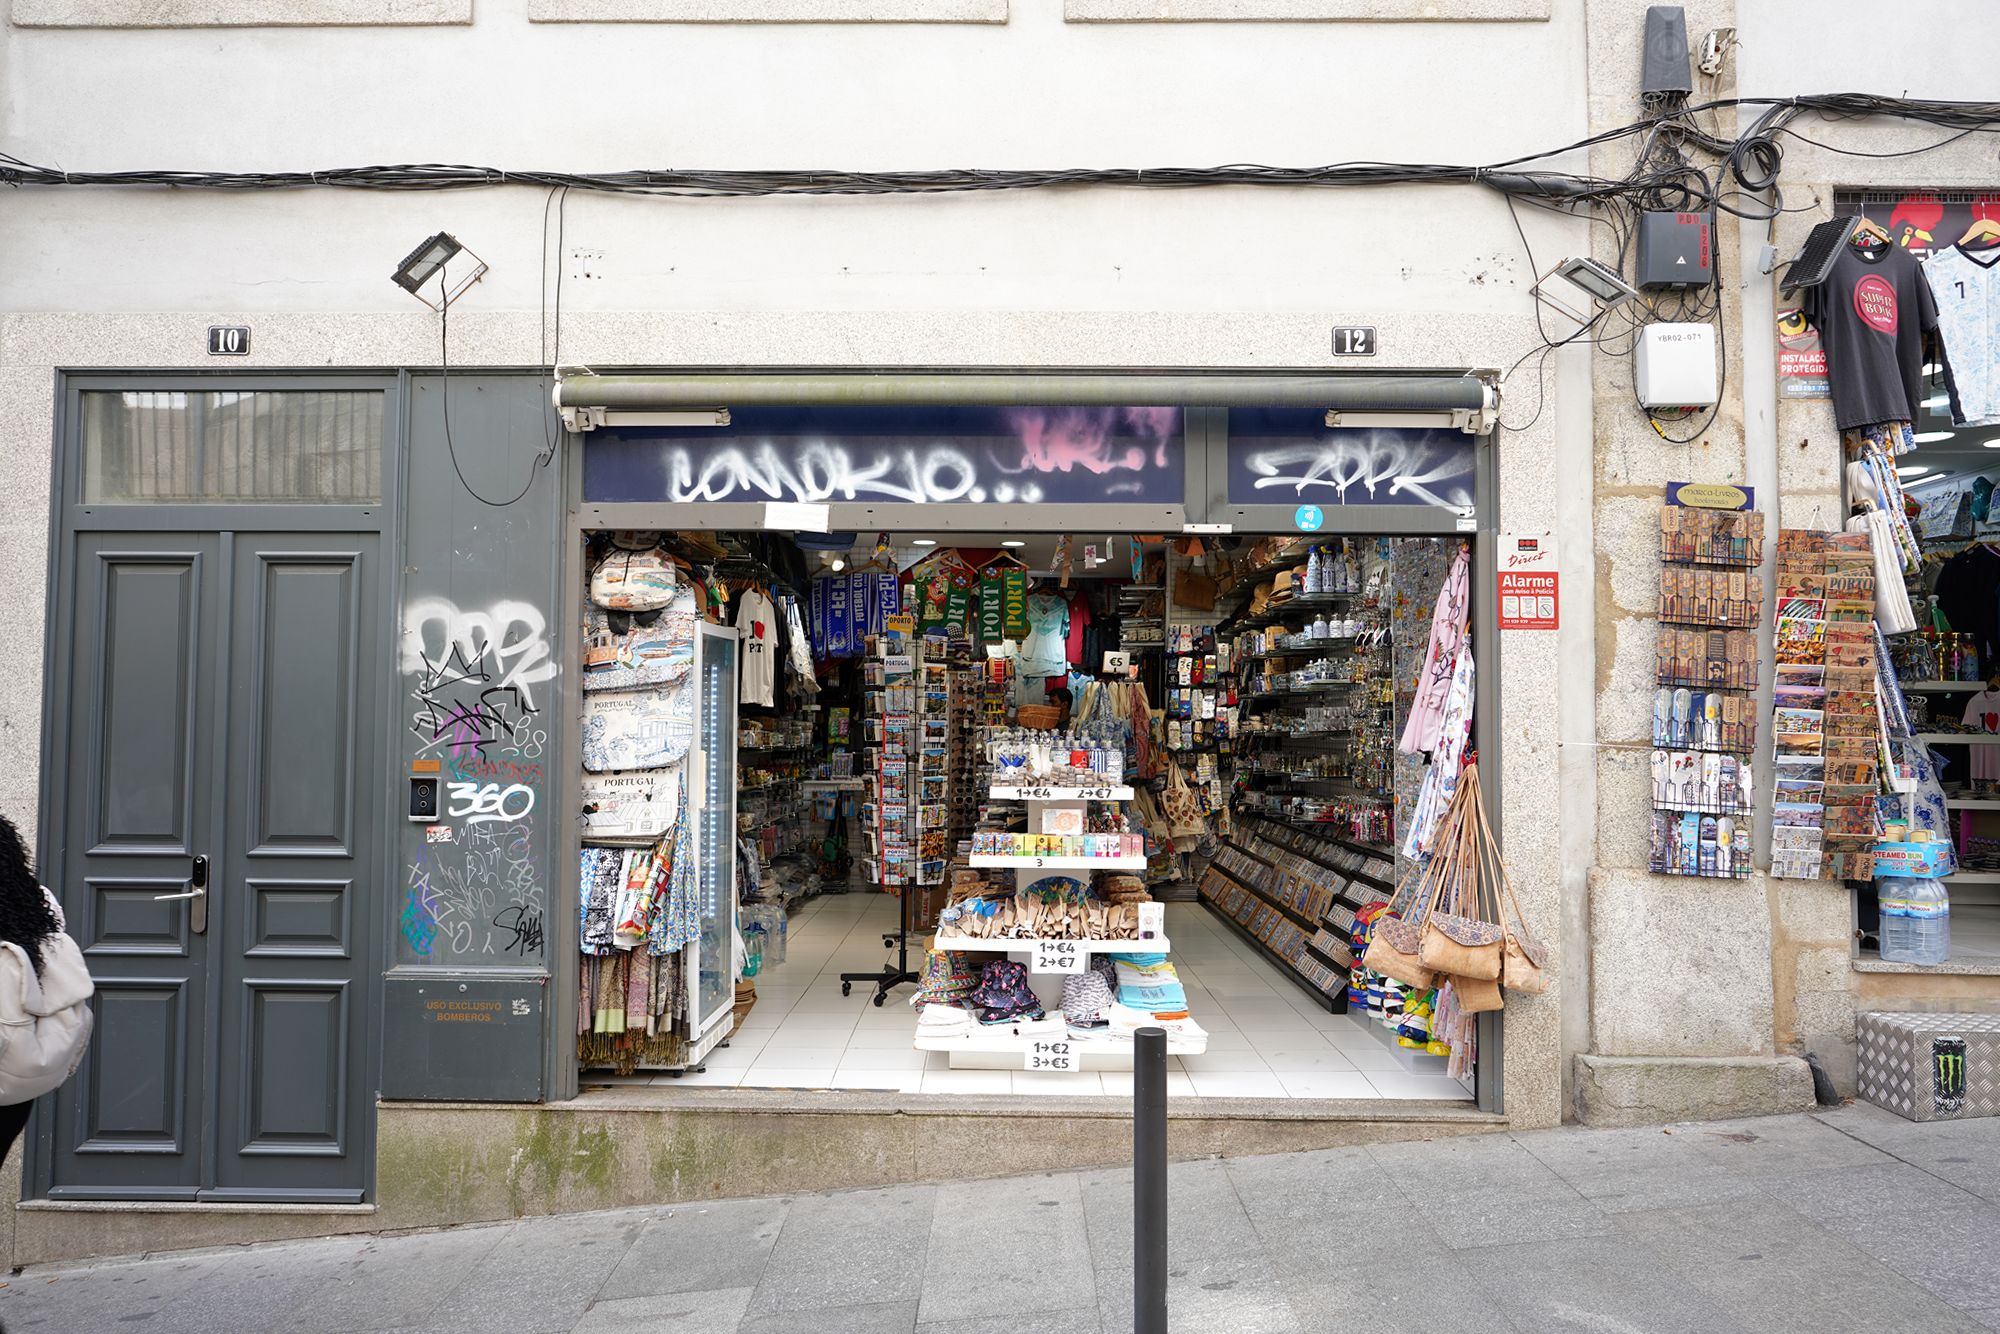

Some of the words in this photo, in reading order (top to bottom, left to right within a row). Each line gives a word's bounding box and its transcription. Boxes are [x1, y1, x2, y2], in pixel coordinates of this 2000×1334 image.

[1955, 281, 1965, 299] 7
[218, 329, 239, 352] 10
[1343, 329, 1366, 353] 12
[1508, 550, 1549, 568] Direct
[1502, 574, 1555, 588] Alarme
[1829, 576, 1875, 591] PORTO
[853, 588, 865, 622] FUTEBOL
[1006, 577, 1023, 627] PORT
[983, 586, 1000, 638] PORT
[889, 616, 912, 624] OPORTO
[1109, 657, 1123, 667] €5
[594, 700, 634, 710] PORTUGAL
[604, 777, 657, 787] PORTUGAL
[446, 781, 535, 822] 360
[1873, 851, 1906, 859] STEAMED
[1036, 859, 1043, 867] 3
[426, 1001, 446, 1010] USO
[448, 1001, 502, 1011] EXCLUSIVO
